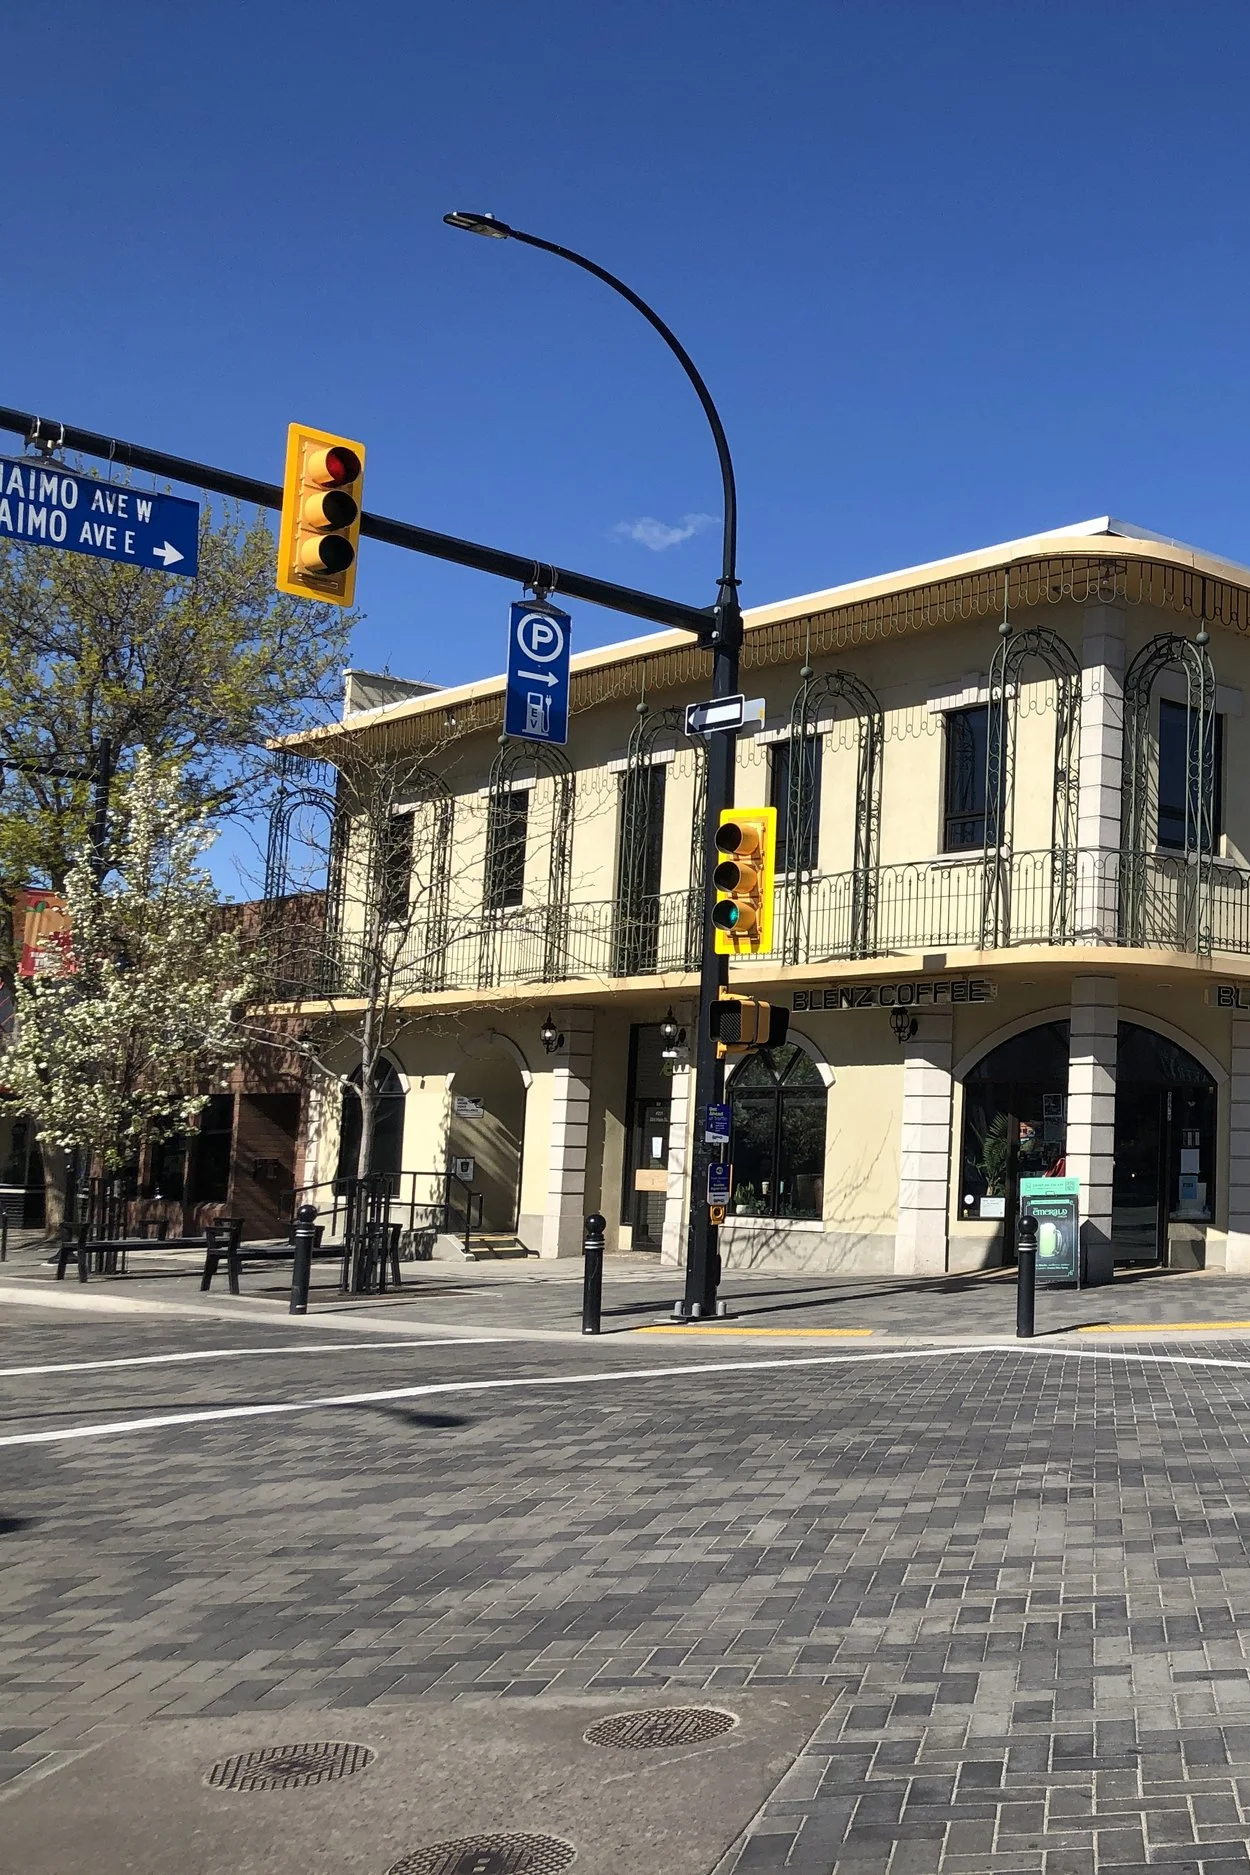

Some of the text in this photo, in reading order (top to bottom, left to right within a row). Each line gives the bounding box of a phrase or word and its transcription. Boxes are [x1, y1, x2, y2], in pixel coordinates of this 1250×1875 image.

[0, 462, 152, 523] AIMO AVE W
[79, 521, 117, 550] AVE
[124, 531, 135, 554] E
[531, 623, 553, 651] P
[792, 980, 985, 1011] BLENZ COFFEE
